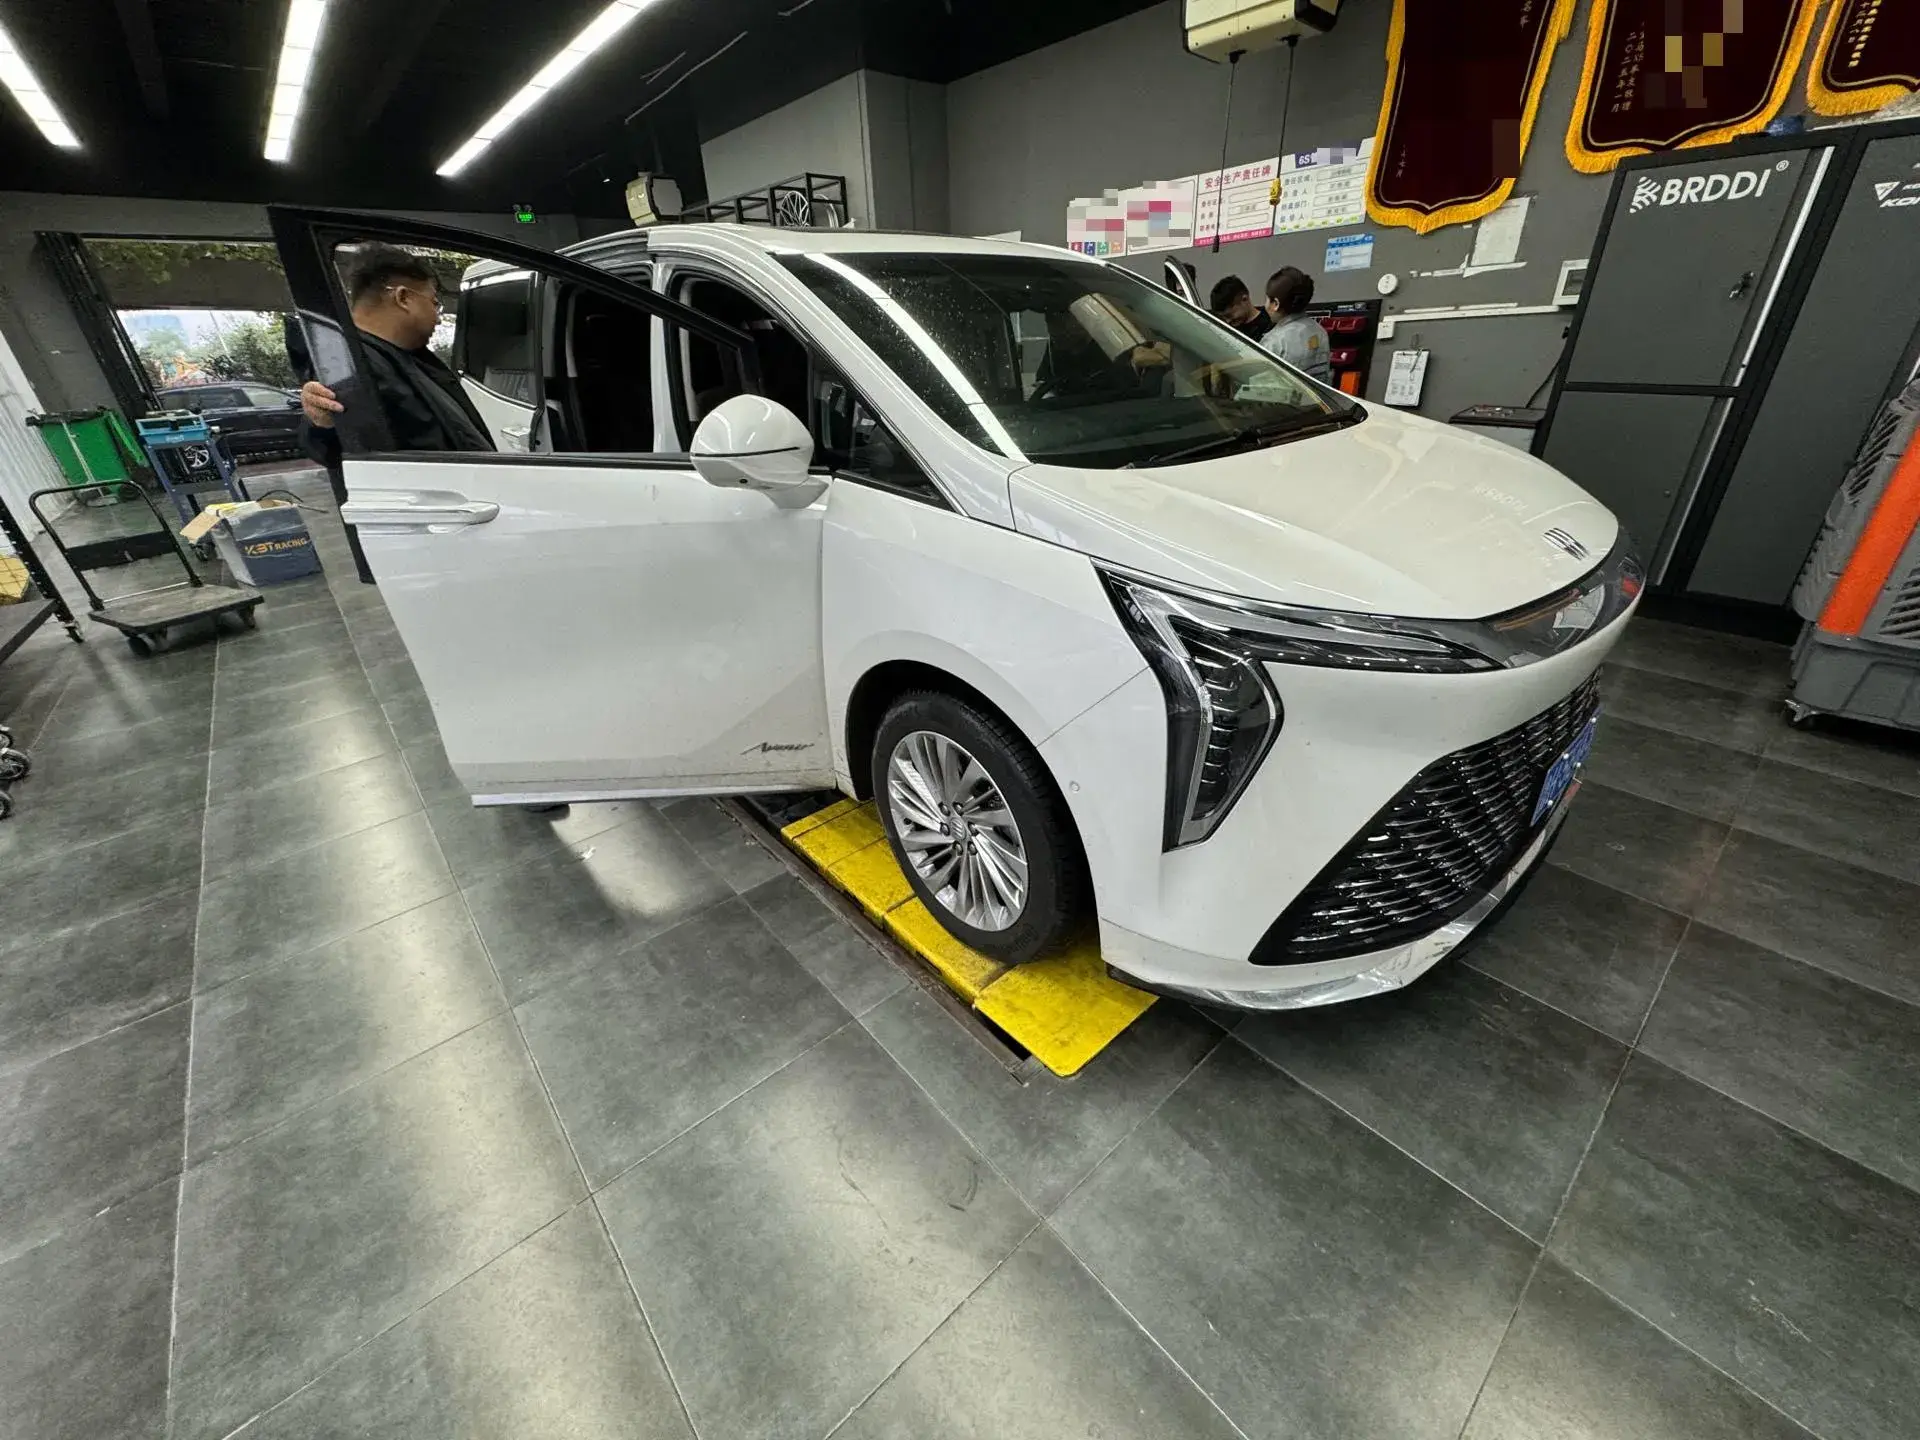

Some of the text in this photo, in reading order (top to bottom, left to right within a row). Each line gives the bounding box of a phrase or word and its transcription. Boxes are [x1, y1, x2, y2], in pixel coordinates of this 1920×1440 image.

[1204, 164, 1272, 189] 安全生产责任牌
[1659, 168, 1772, 206] BRDDI
